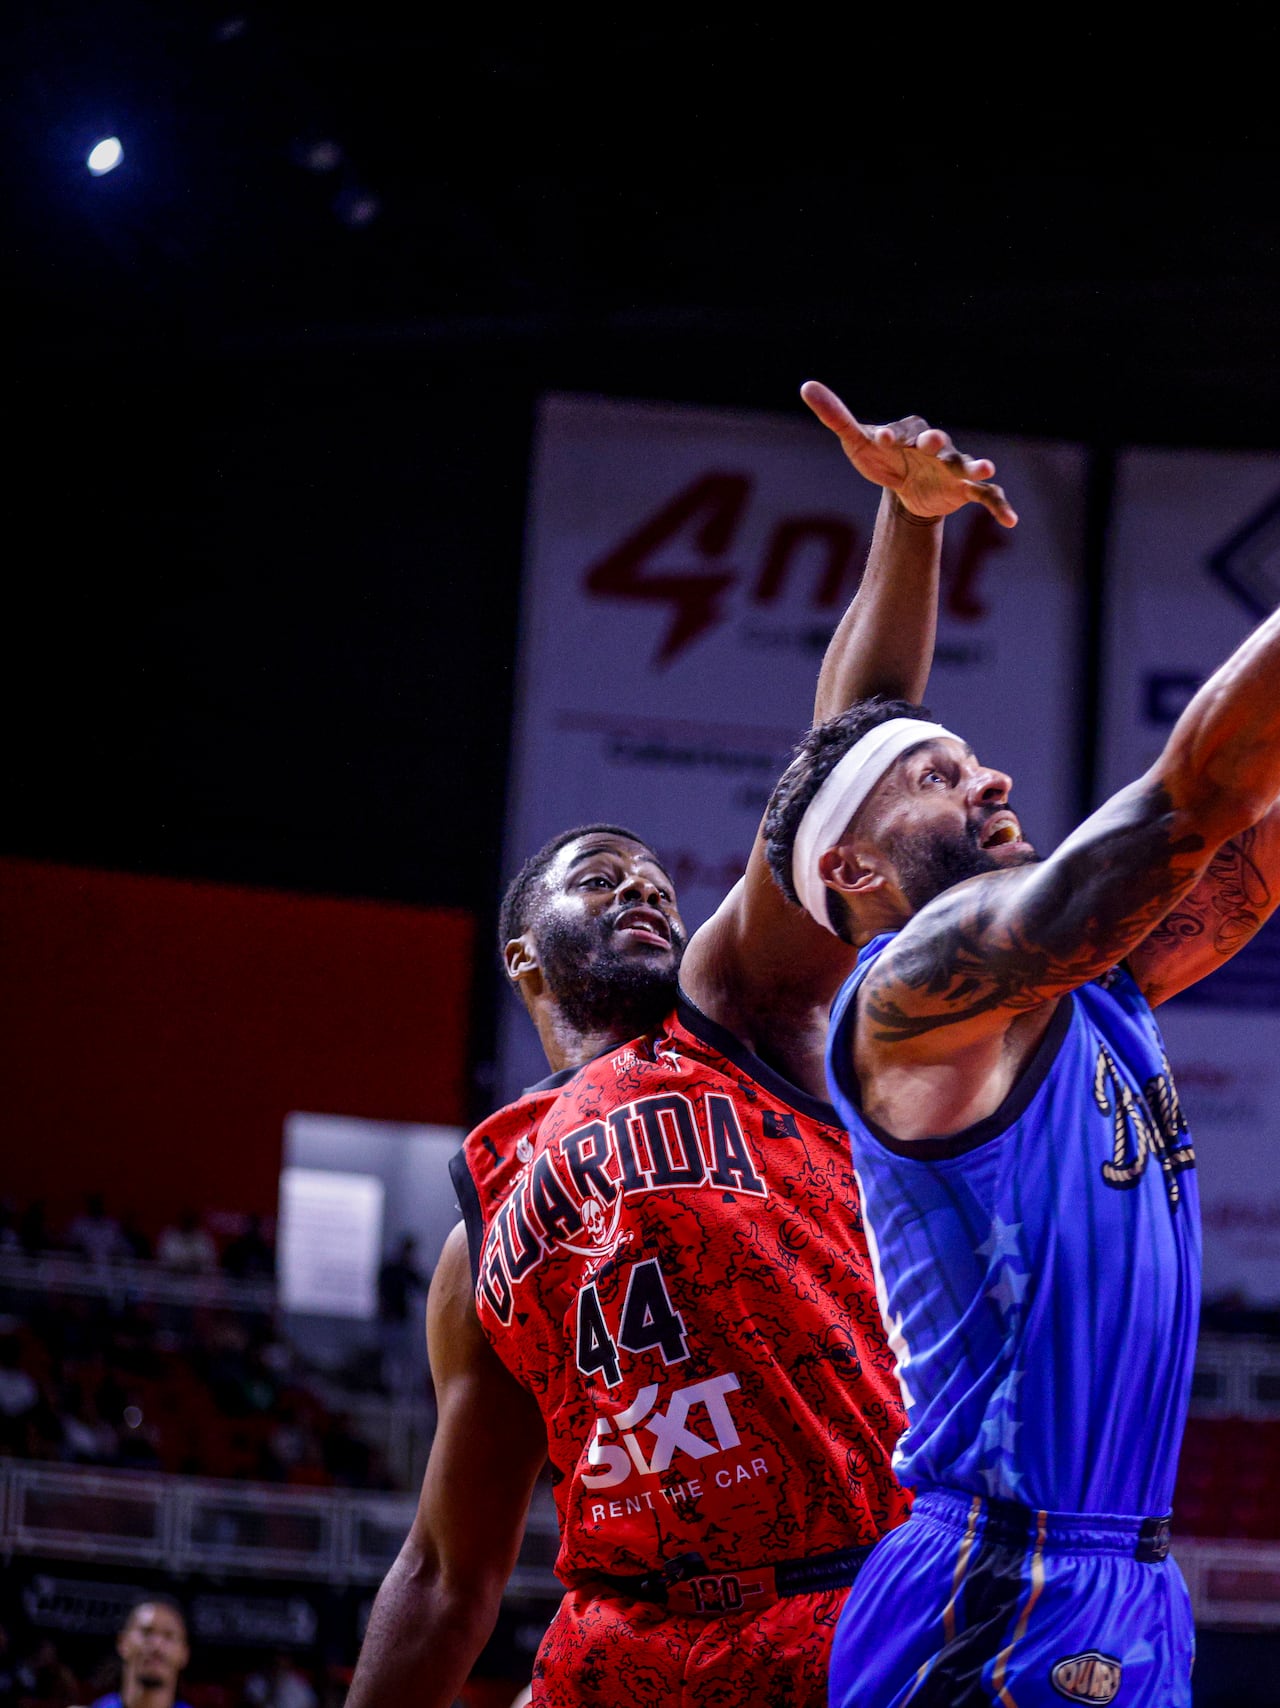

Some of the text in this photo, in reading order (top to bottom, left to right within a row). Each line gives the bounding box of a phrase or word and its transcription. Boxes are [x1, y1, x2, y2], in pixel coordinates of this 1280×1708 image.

[475, 1092, 768, 1328] GUARIDA
[576, 1256, 691, 1389] 44
[580, 1371, 742, 1491] SIXT
[590, 1456, 769, 1523] RENT THE CAR
